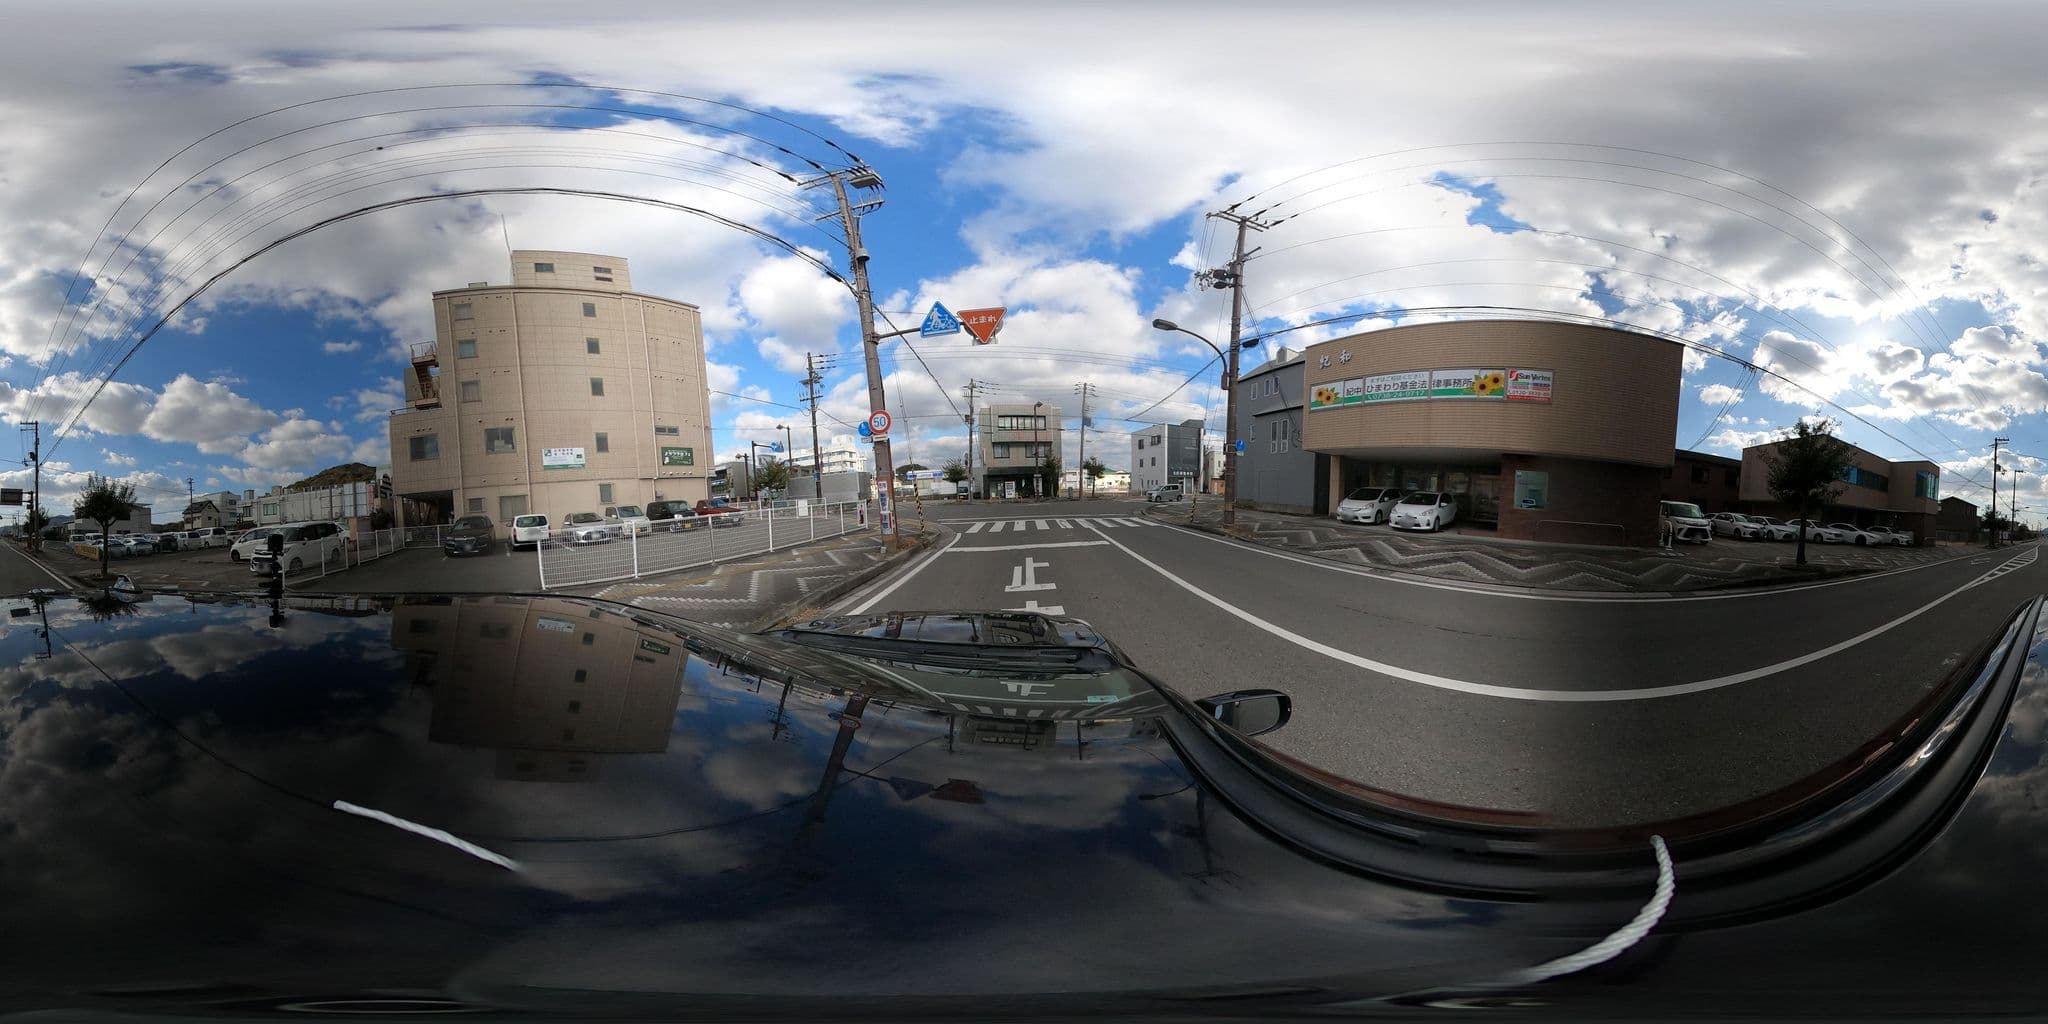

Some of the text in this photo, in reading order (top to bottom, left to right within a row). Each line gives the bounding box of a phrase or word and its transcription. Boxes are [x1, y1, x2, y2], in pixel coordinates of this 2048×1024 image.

[969, 314, 997, 325] 止まれ
[873, 416, 886, 427] 50
